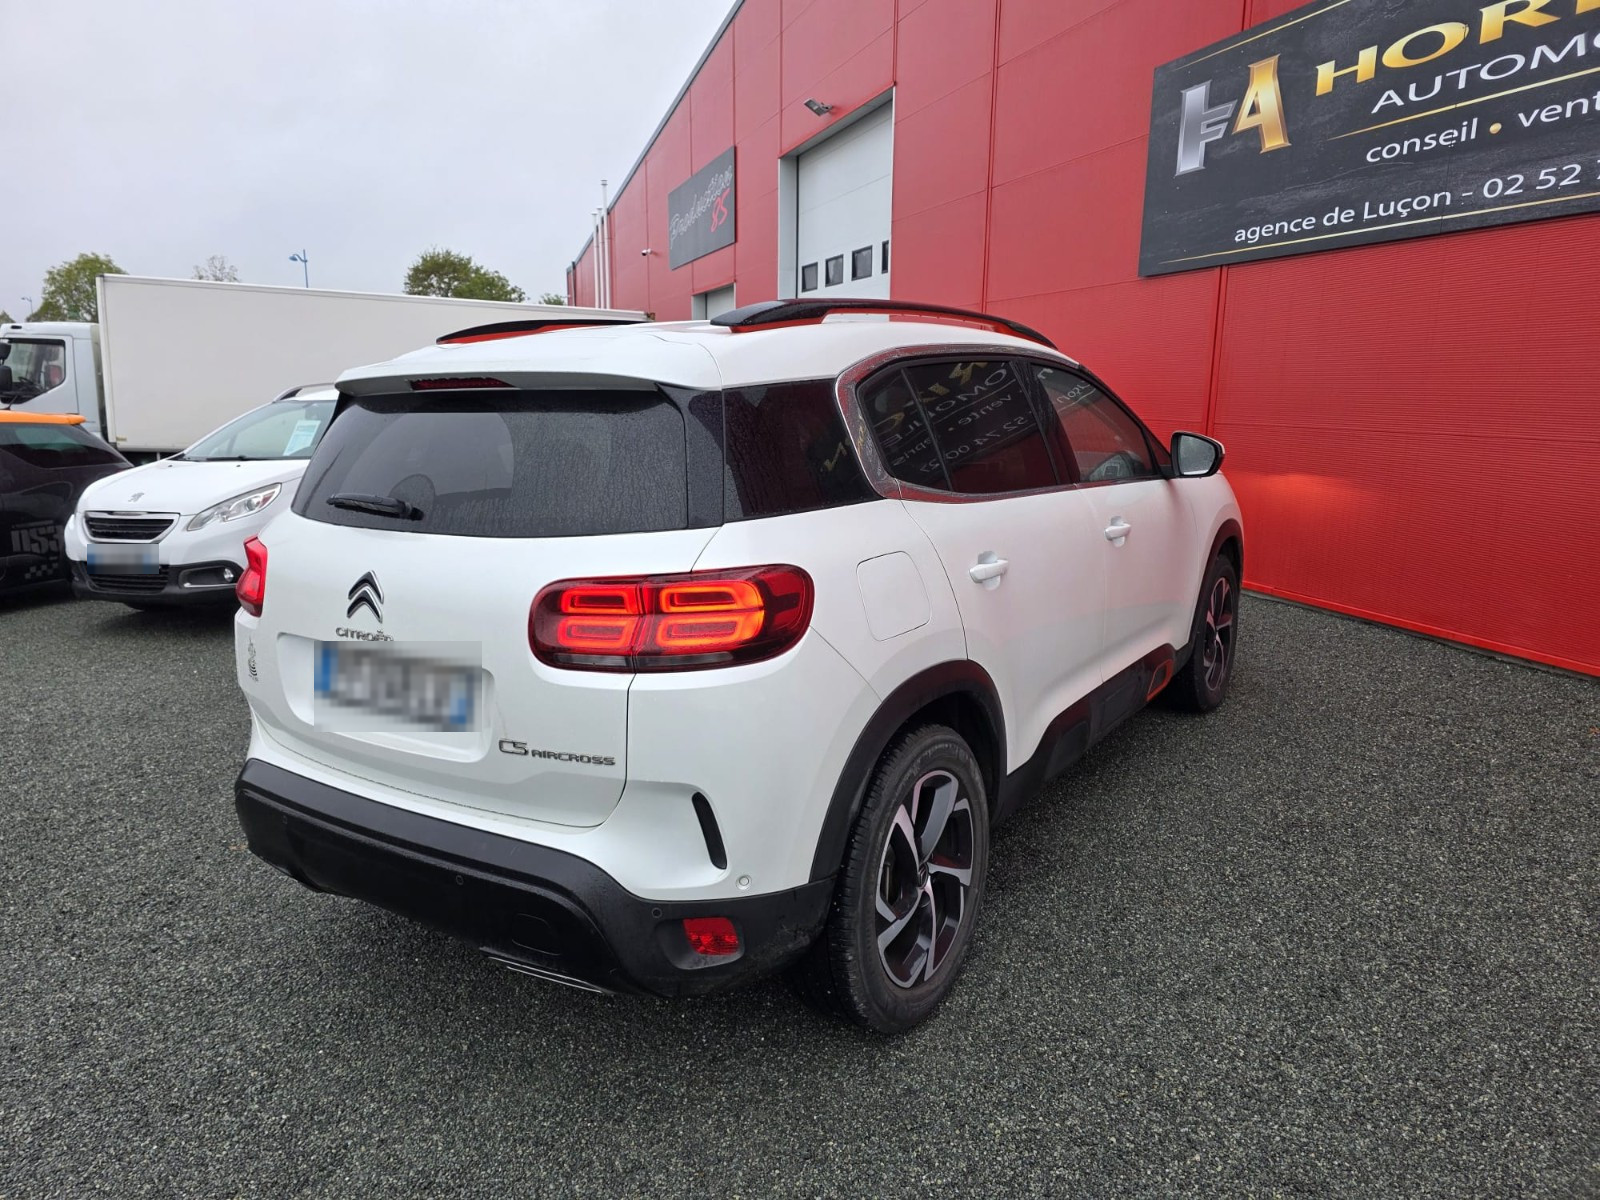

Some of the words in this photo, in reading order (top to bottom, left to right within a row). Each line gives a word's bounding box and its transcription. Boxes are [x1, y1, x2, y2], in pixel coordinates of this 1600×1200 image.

[1371, 32, 1600, 114] AUTOM
[1366, 117, 1477, 163] conseil
[1234, 214, 1316, 244] agence
[1322, 205, 1355, 227] de
[1364, 190, 1452, 220] Luçon
[1483, 174, 1525, 199] 02
[1535, 163, 1582, 190] 52
[498, 738, 529, 756] C5
[531, 748, 616, 766] AIRCROSS
